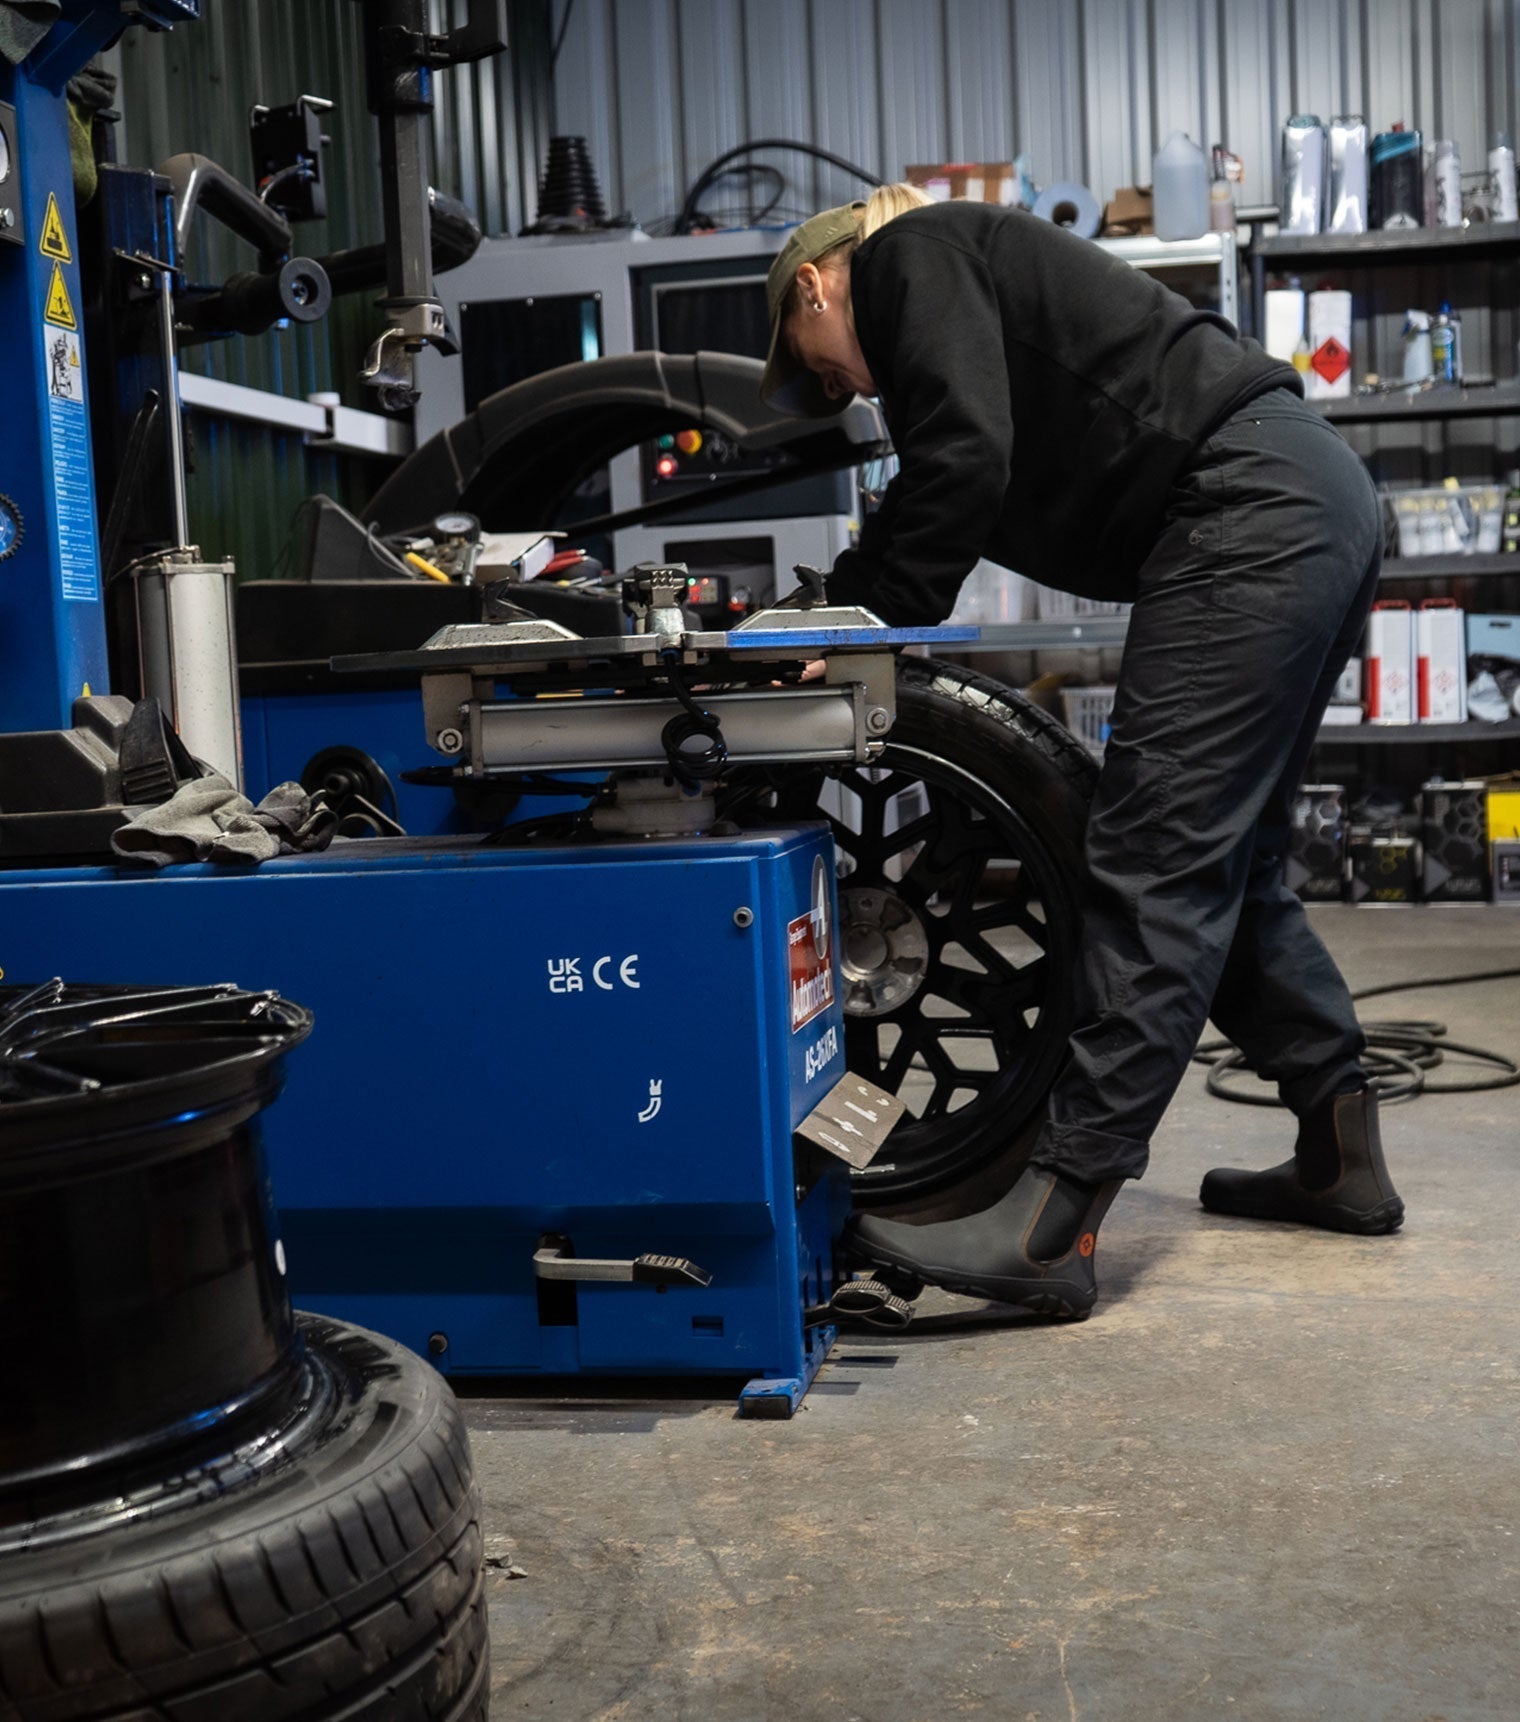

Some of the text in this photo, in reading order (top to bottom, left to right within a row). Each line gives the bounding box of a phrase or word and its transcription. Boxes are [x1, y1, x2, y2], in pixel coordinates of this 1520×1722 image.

[548, 954, 640, 990] UK CE
[549, 975, 584, 993] CA
